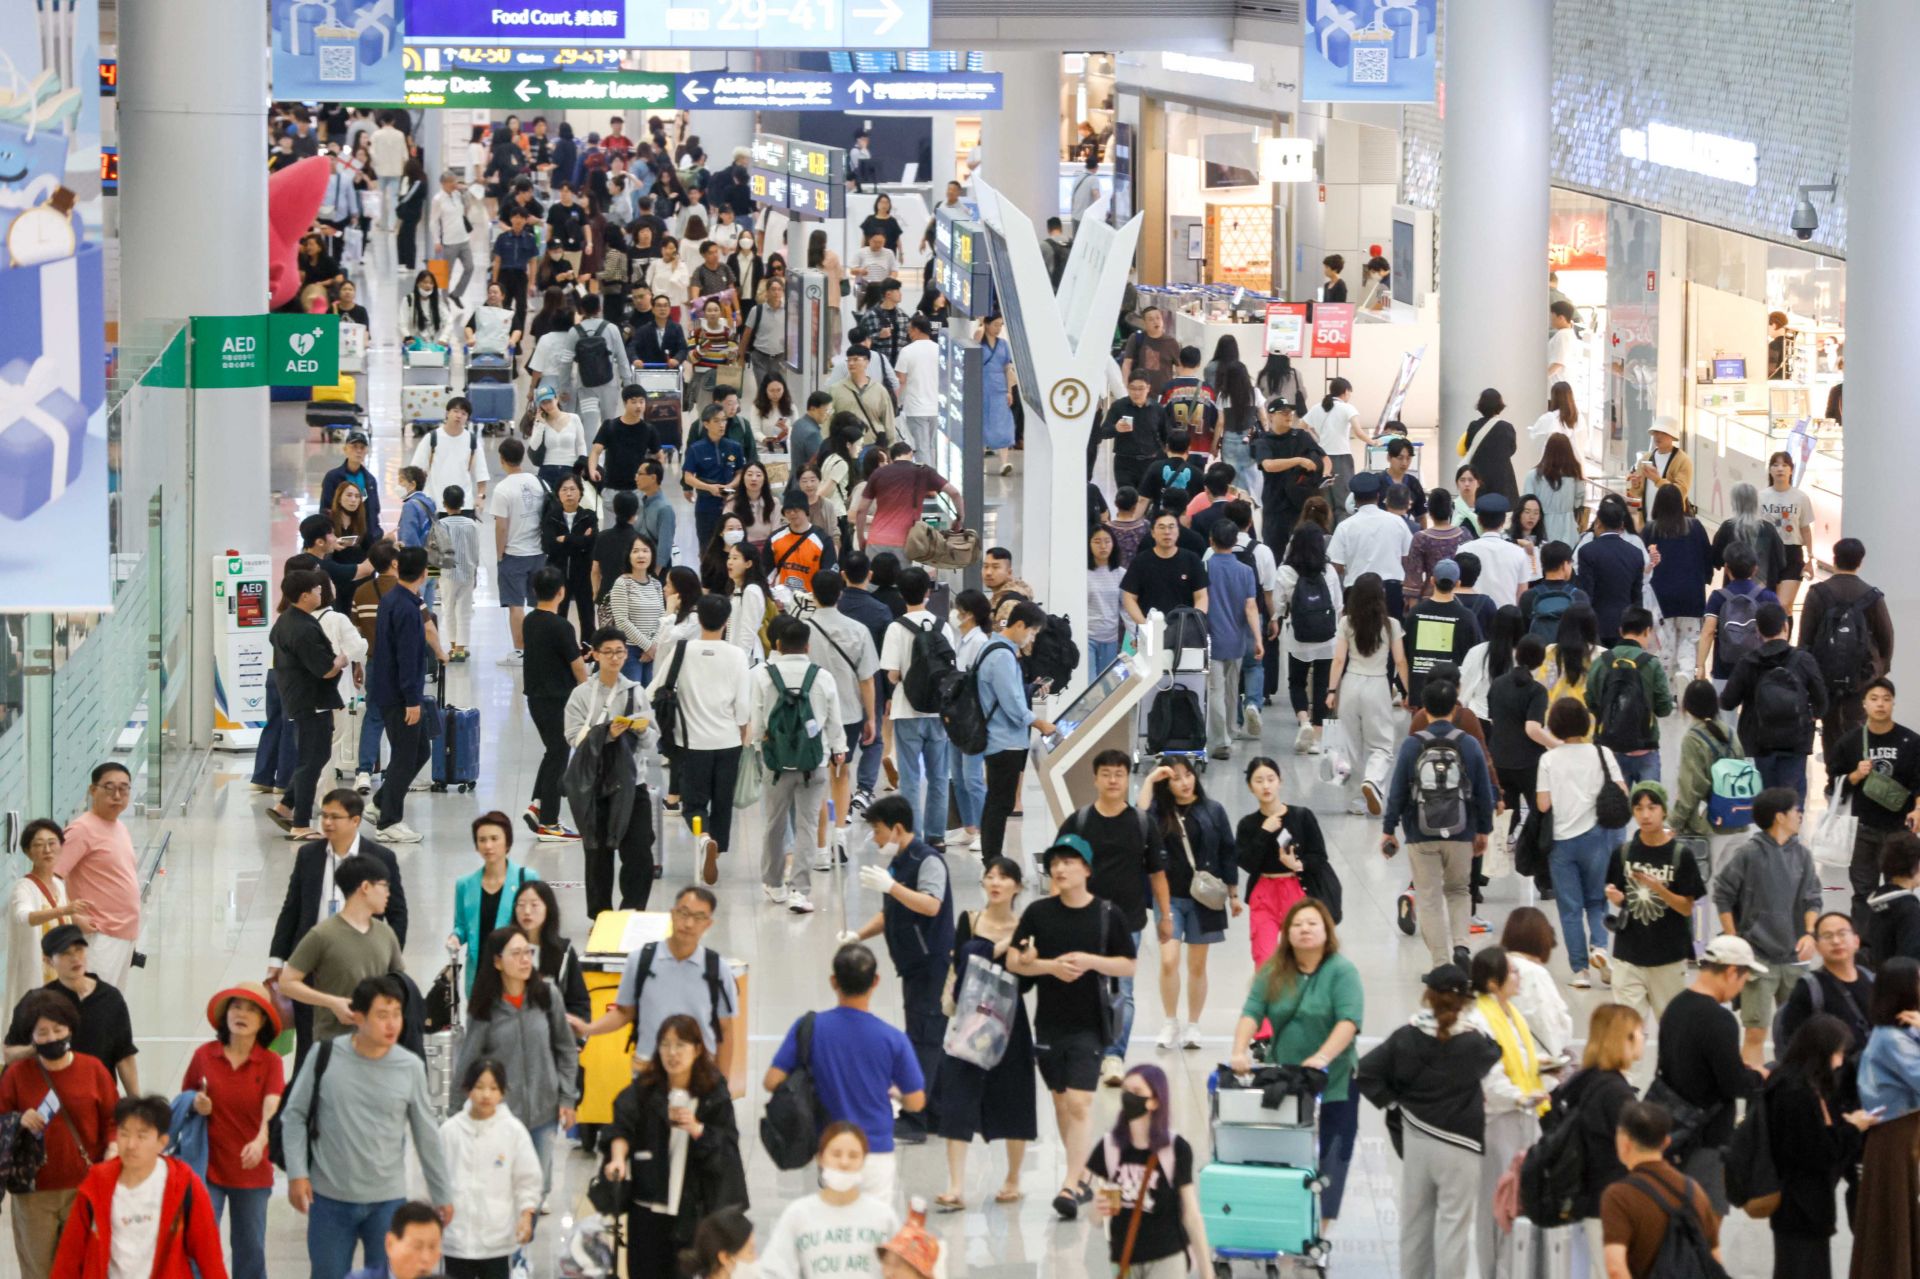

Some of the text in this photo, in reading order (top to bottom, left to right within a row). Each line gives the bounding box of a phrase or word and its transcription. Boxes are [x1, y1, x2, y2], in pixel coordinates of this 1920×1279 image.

[491, 9, 529, 24] Food
[450, 76, 492, 93] Desk
[544, 79, 669, 102] Transfer Lounge
[713, 77, 832, 99] Airline Lounges
[222, 336, 256, 352] AED
[286, 359, 319, 372] AED
[1762, 504, 1798, 514] Mardi
[241, 583, 263, 593] AED
[1869, 746, 1898, 760] LEGE
[824, 1227, 852, 1244] ARE
[810, 1254, 870, 1273] YOU ARE
